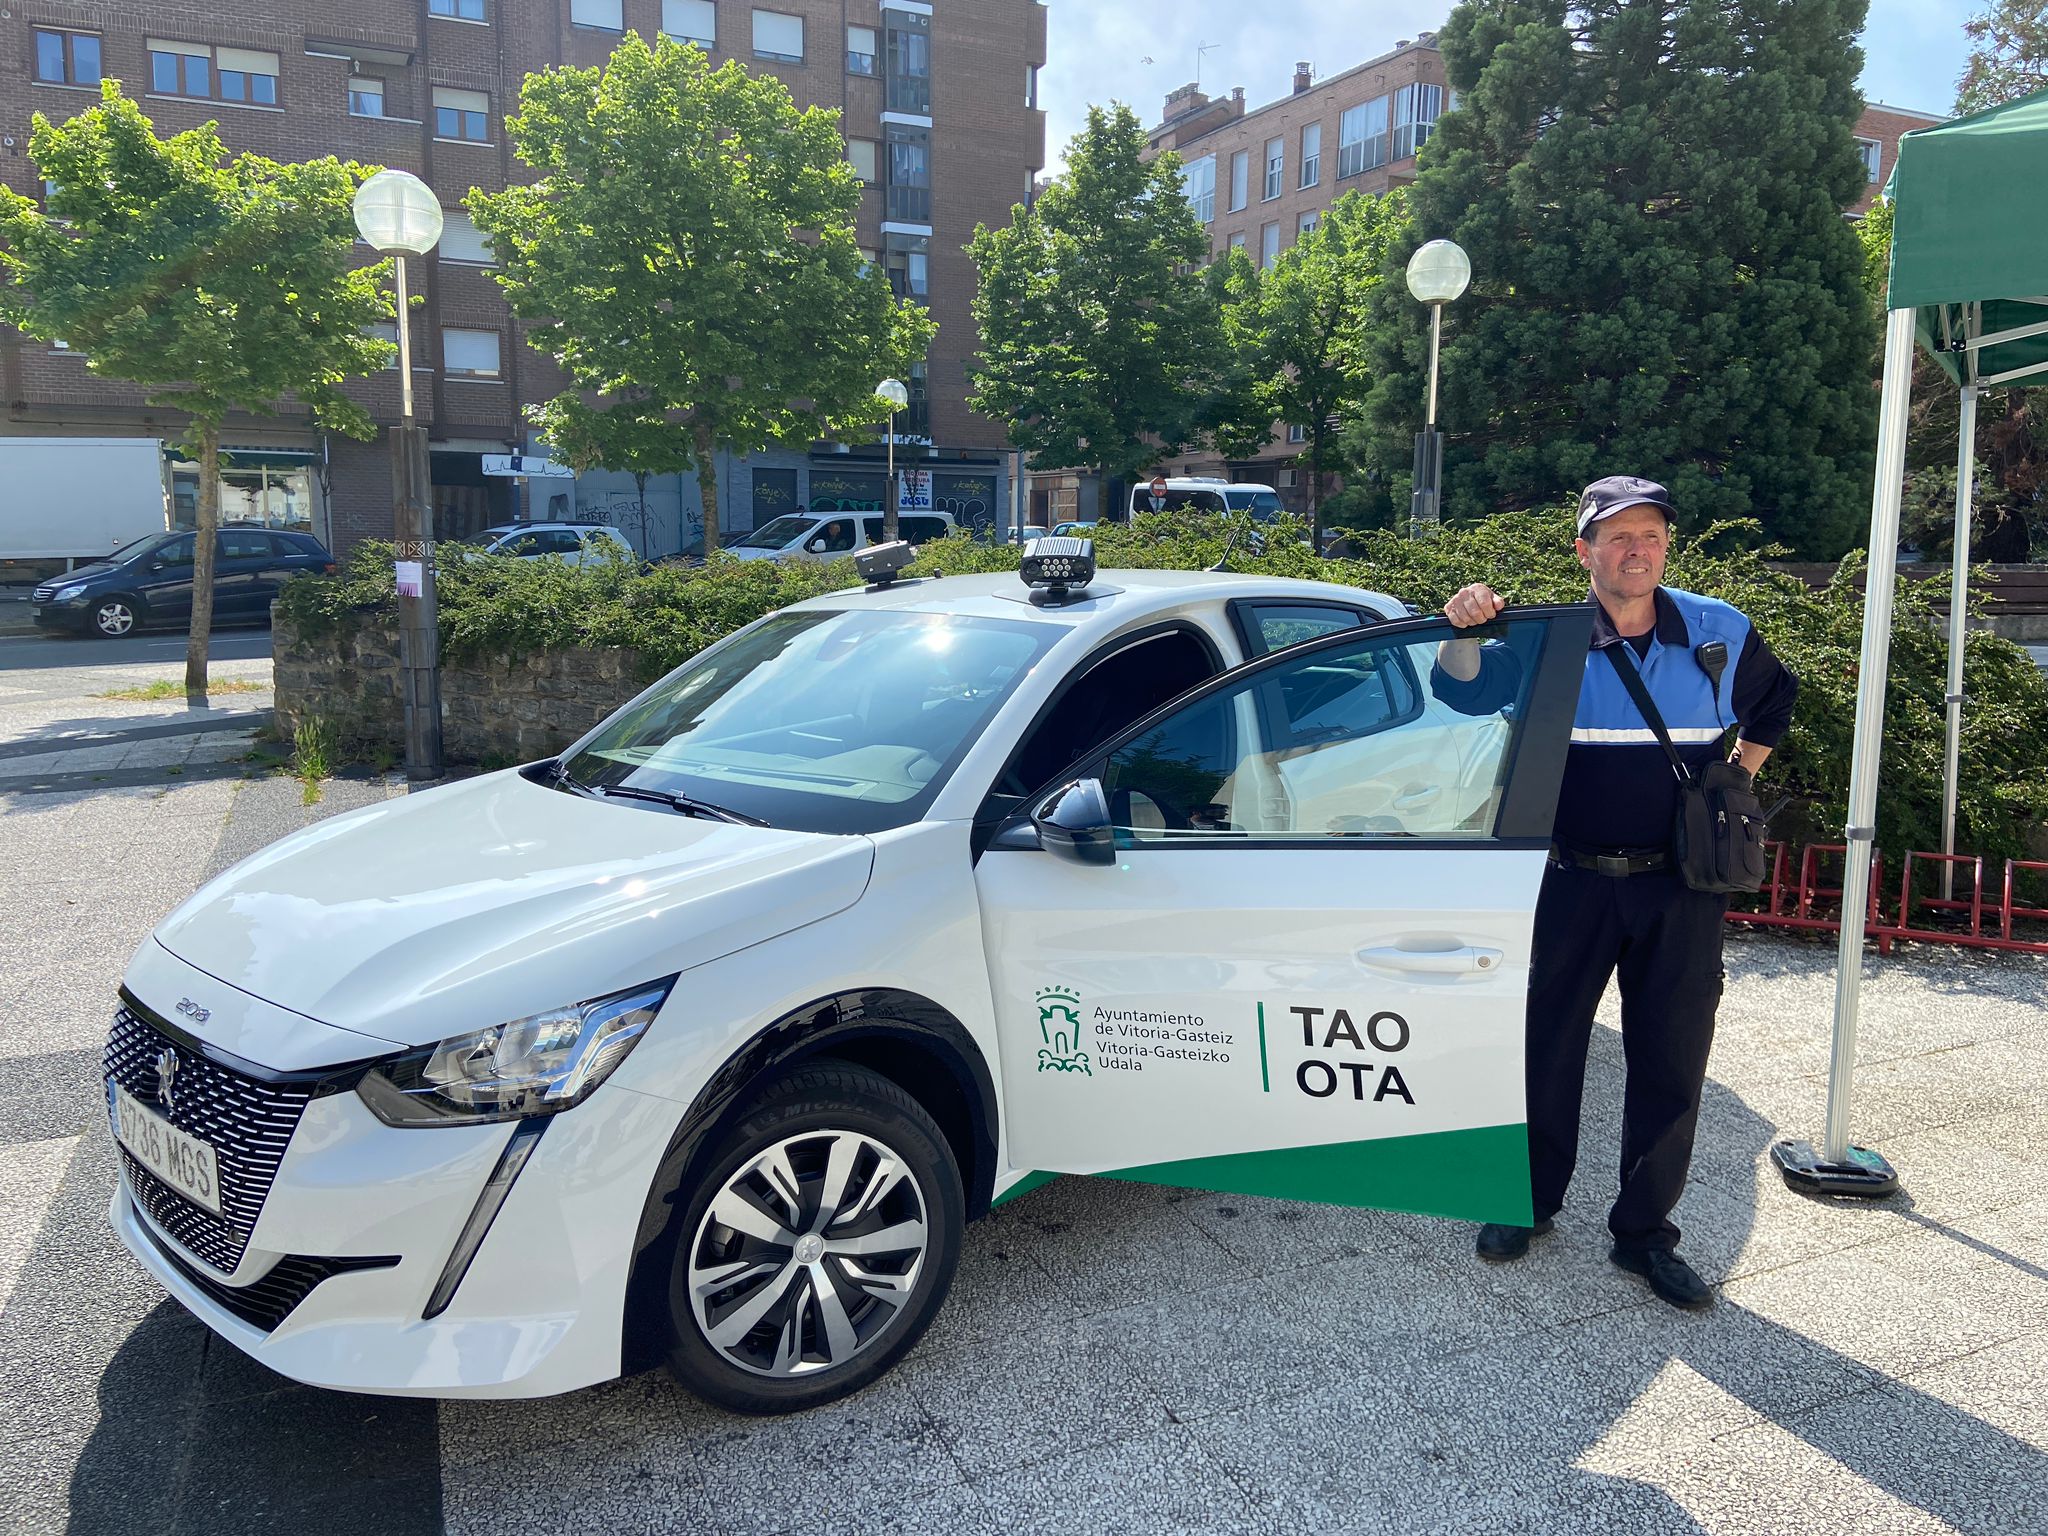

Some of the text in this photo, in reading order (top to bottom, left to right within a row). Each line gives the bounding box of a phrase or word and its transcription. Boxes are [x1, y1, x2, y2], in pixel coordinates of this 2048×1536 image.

[901, 496, 929, 506] JOSU
[175, 996, 211, 1023] 208
[1094, 1006, 1204, 1026] Ayuntamiento
[1095, 1022, 1234, 1045] de Vitoria-Gasteiz
[1290, 1006, 1410, 1052] TAO
[1096, 1041, 1230, 1063] Vitoria-Gasteizko
[1099, 1056, 1143, 1071] Udala
[1296, 1060, 1416, 1105] OTA
[166, 1131, 211, 1197] MGS
